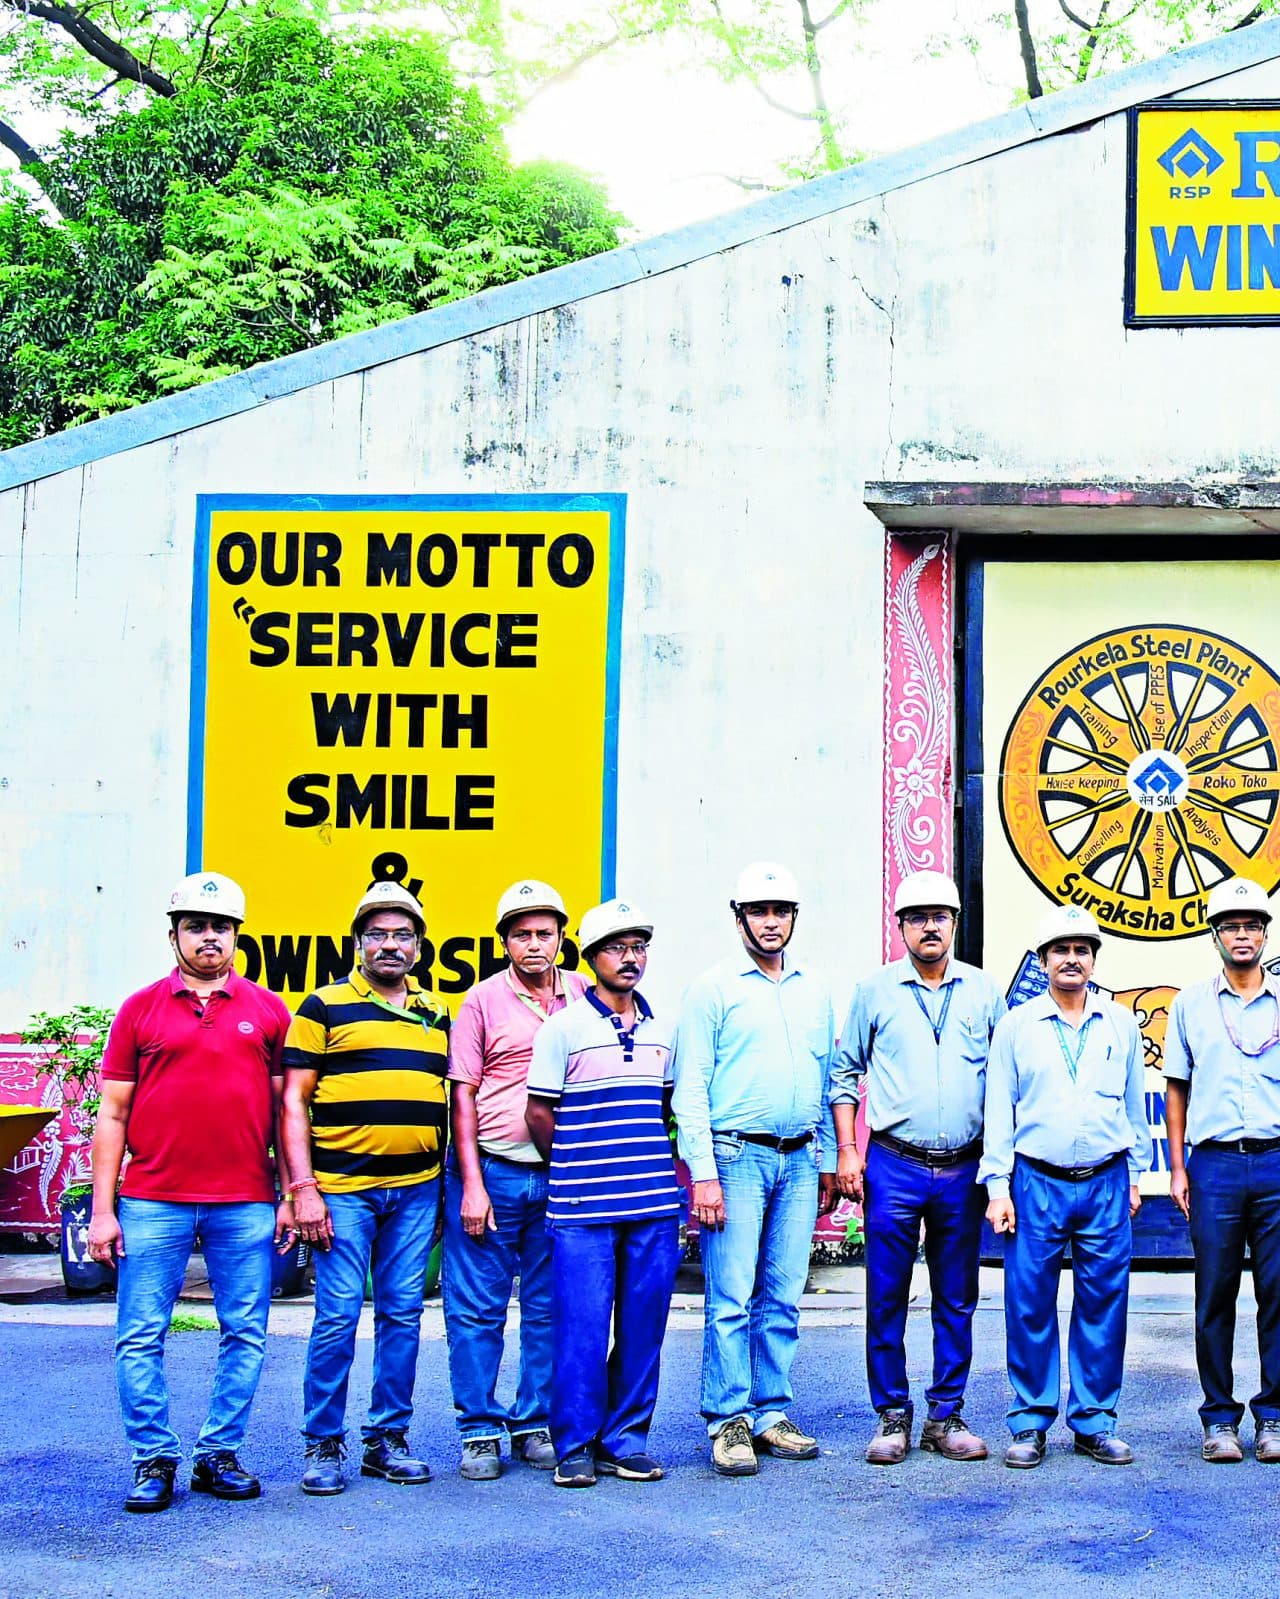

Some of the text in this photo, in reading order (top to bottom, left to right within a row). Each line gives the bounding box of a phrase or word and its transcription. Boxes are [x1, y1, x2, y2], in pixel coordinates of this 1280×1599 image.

[1169, 186, 1211, 199] RSP
[216, 531, 595, 588] OUR MOTTO
[1037, 634, 1253, 710] Rourkela Steel Plant
[311, 692, 489, 749] WITH
[1079, 703, 1119, 749] Training
[1150, 664, 1166, 741] Use of PPES
[1185, 709, 1233, 758] Inspection
[285, 774, 495, 831] SMILE
[1157, 795, 1178, 807] SAIL
[1203, 774, 1267, 789] Roko Toko
[1183, 807, 1222, 847] Analysis
[1152, 823, 1165, 889] Motivation
[1056, 873, 1175, 931] Suraksha
